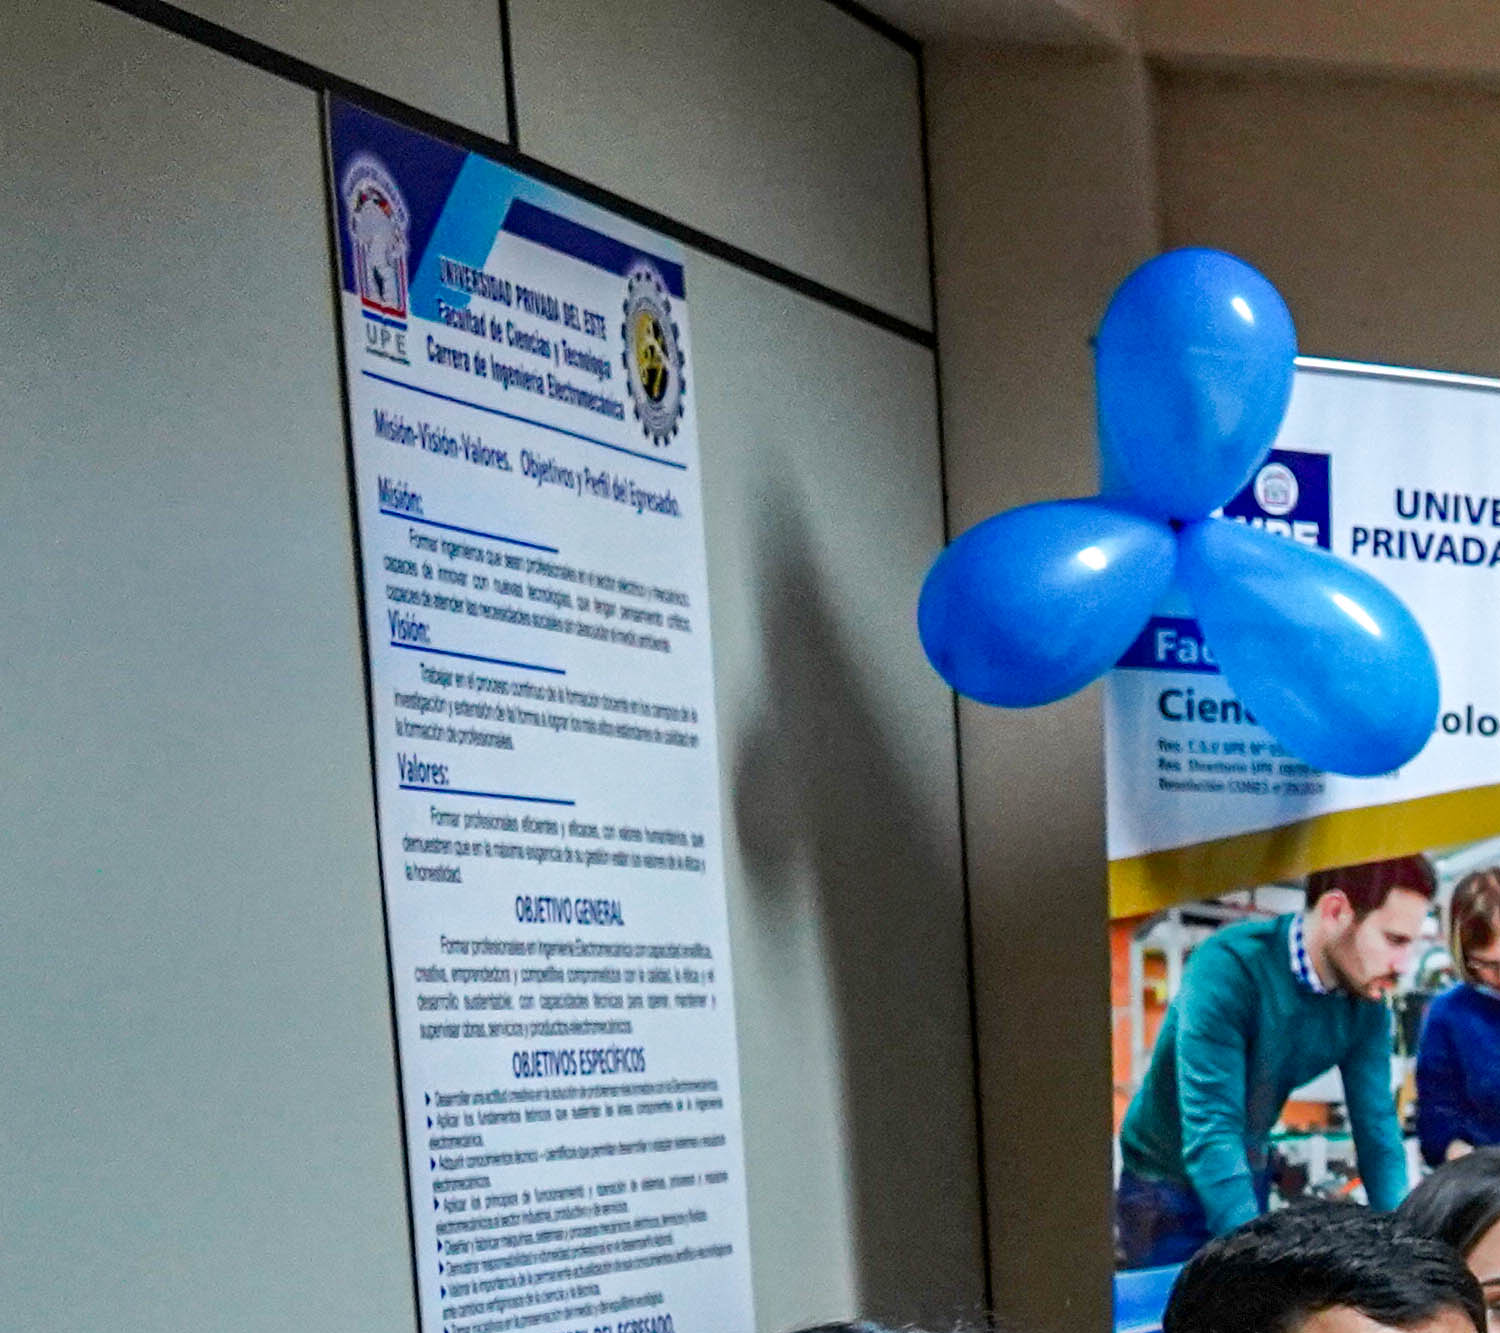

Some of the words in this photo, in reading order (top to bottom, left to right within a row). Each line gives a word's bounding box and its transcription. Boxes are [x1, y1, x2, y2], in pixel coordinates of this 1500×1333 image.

[439, 255, 512, 307] UNIVERSIDAD
[516, 284, 559, 324] PRIVADA
[564, 300, 582, 332] DEL
[584, 310, 607, 340] ESTE
[366, 322, 407, 356] UPE
[437, 298, 486, 339] Facultad
[490, 316, 502, 343] de
[506, 318, 551, 358] Ciencias
[427, 333, 471, 370] Carrera
[474, 351, 488, 377] de
[377, 475, 424, 514] Misión:
[520, 450, 574, 491] Objetivos
[584, 466, 611, 497] Perfil
[614, 476, 629, 502] del
[388, 609, 431, 644] Visión:
[397, 752, 450, 785] Valores:
[515, 895, 571, 925] OBJETIVO
[574, 896, 625, 927] GENERAL
[512, 1047, 577, 1079] OBJETIVOS
[579, 1044, 645, 1075] ESPECÍFICOS
